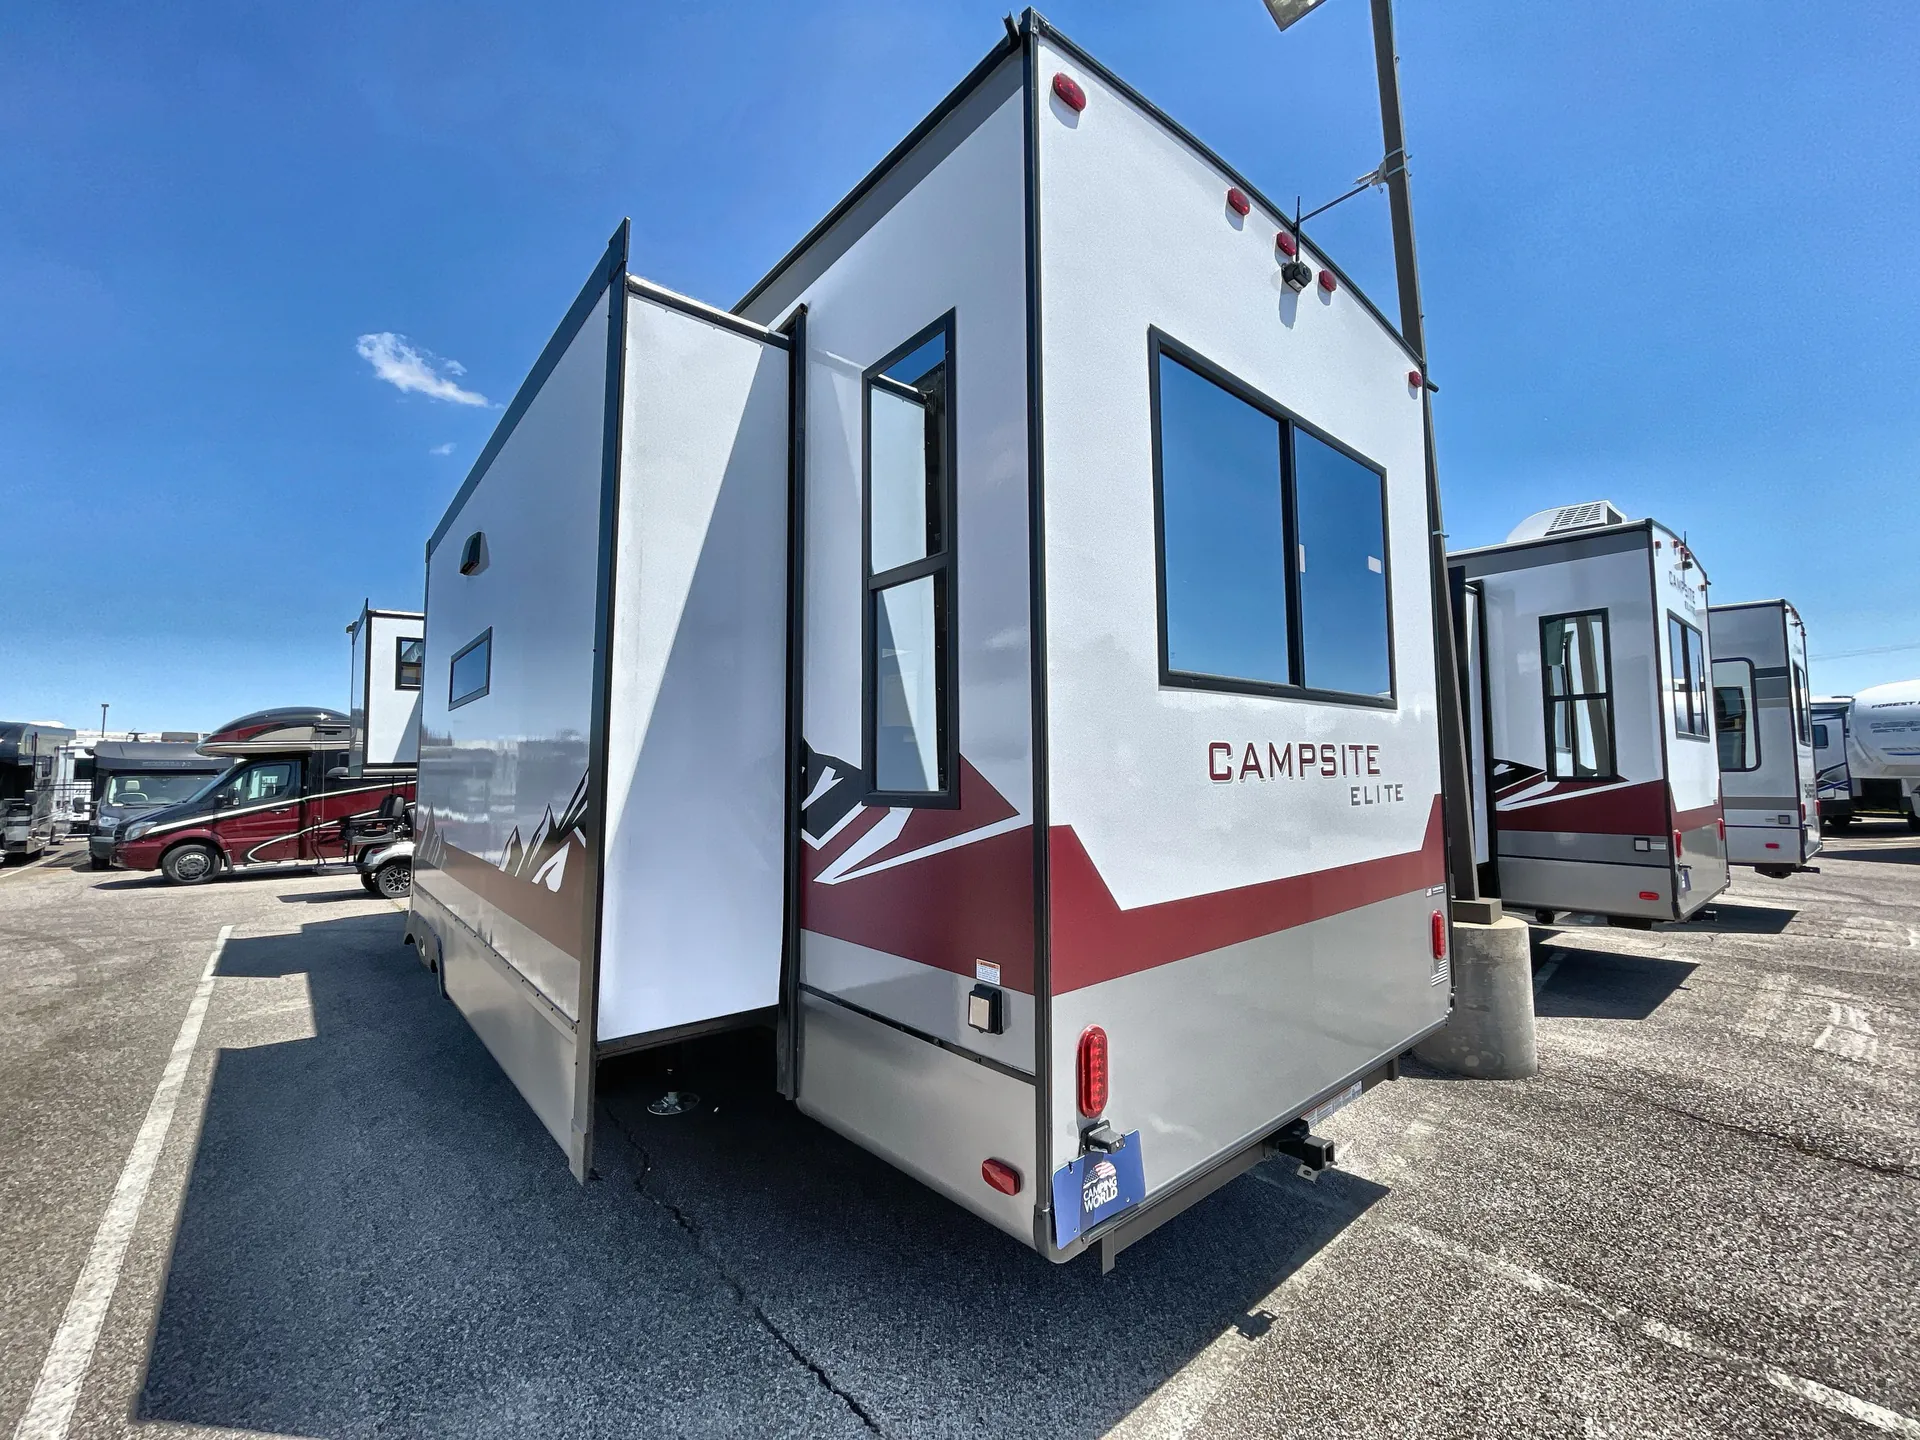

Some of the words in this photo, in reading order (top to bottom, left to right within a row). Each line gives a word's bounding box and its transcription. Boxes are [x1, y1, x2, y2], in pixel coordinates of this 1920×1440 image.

[1871, 701, 1916, 709] FOREST
[1208, 742, 1382, 783] CAMPSITE
[1350, 783, 1404, 806] ELITE
[1083, 1176, 1118, 1201] CAMPING
[1083, 1187, 1119, 1213] WORLD
